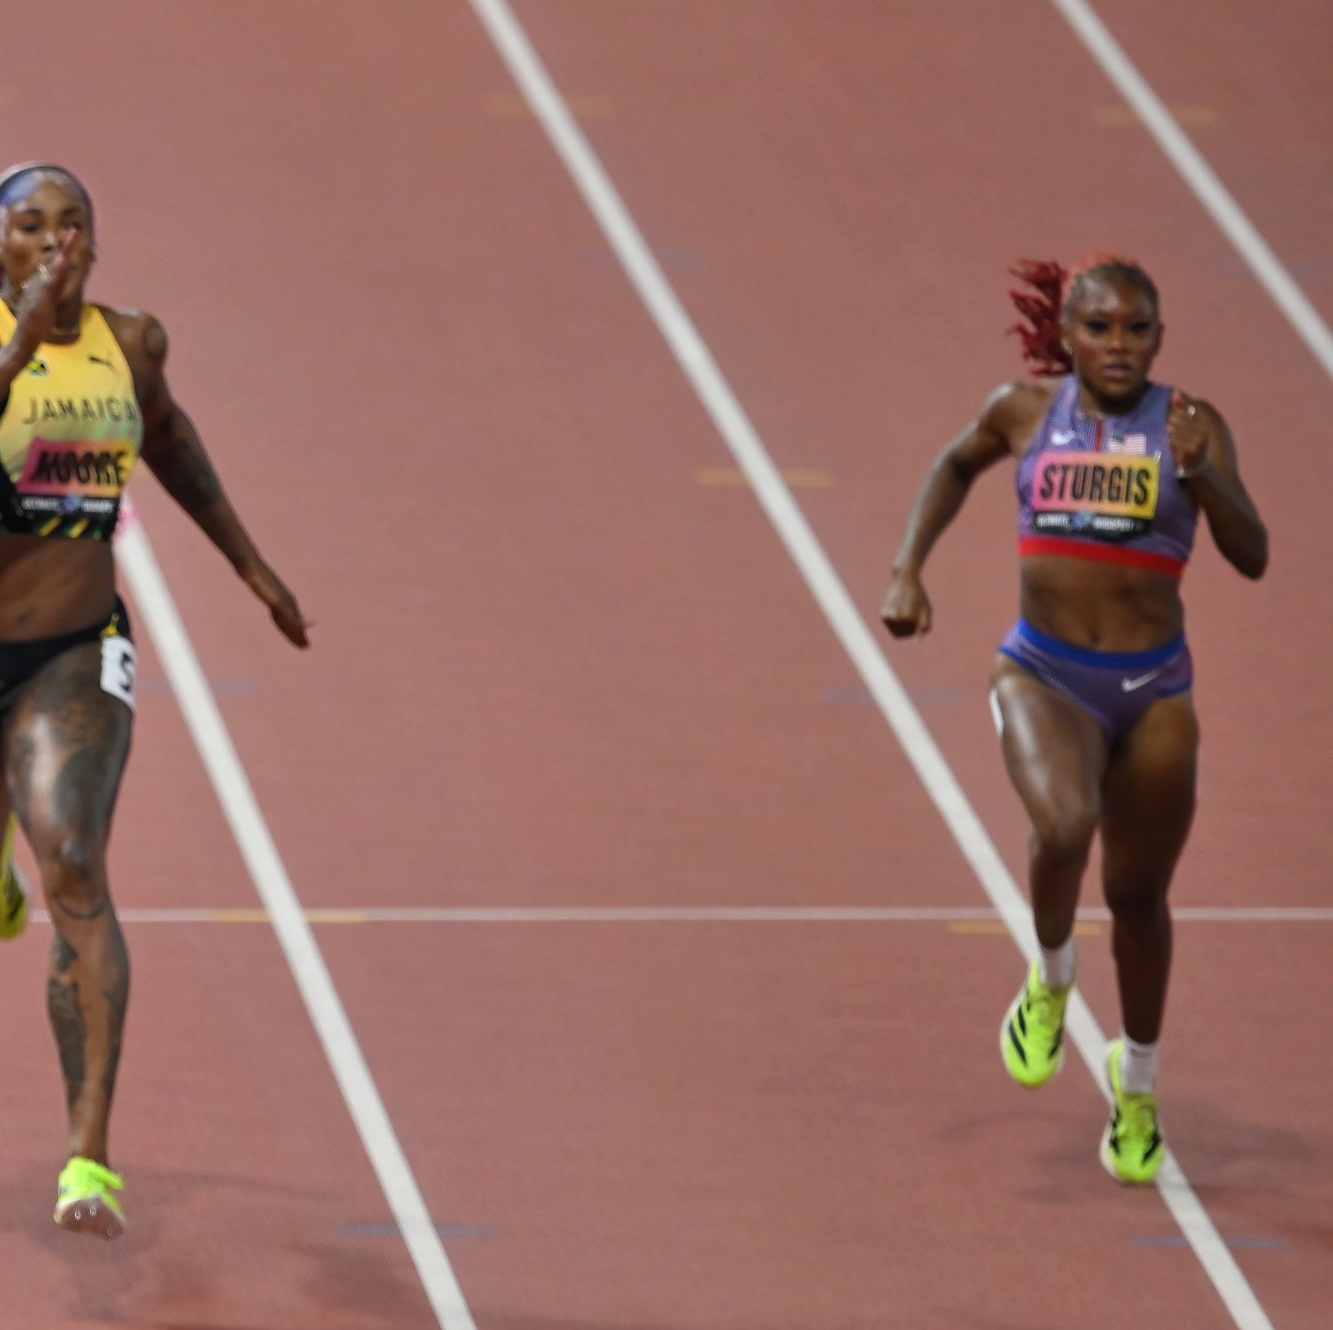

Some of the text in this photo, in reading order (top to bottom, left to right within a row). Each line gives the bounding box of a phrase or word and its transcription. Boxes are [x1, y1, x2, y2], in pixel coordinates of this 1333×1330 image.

[21, 398, 141, 424] JAMAICA
[30, 450, 128, 487] MOORE
[1040, 464, 1151, 505] STURGIS
